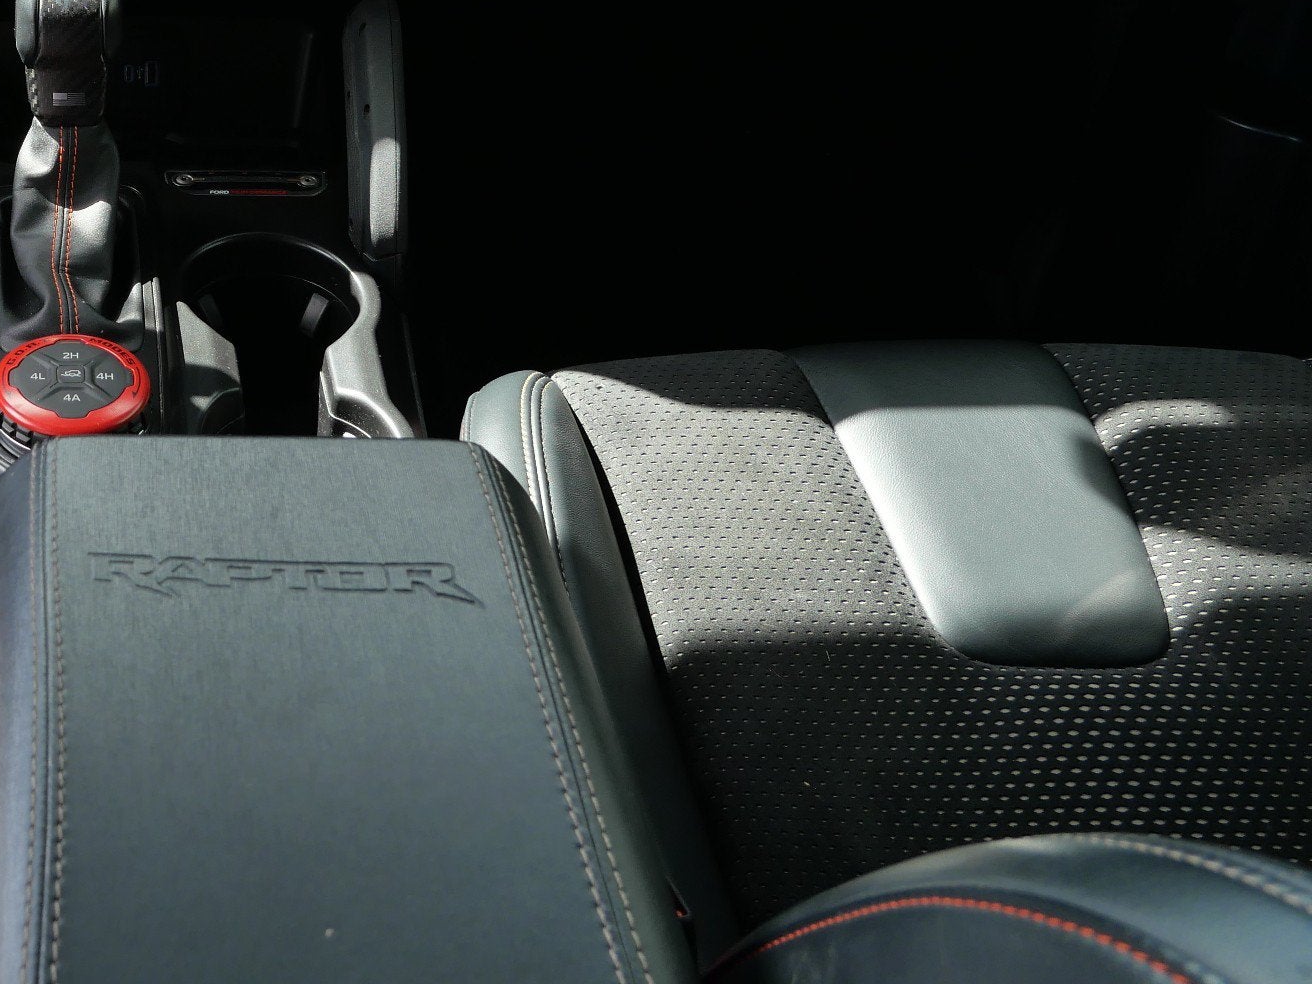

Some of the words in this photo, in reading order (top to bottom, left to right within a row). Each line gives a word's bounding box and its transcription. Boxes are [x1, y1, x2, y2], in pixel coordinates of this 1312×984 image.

[89, 338, 136, 365] MODES
[30, 372, 46, 380] 4L
[96, 372, 114, 381] 4H
[62, 394, 81, 402] 4A
[88, 552, 485, 608] RAPTOR
